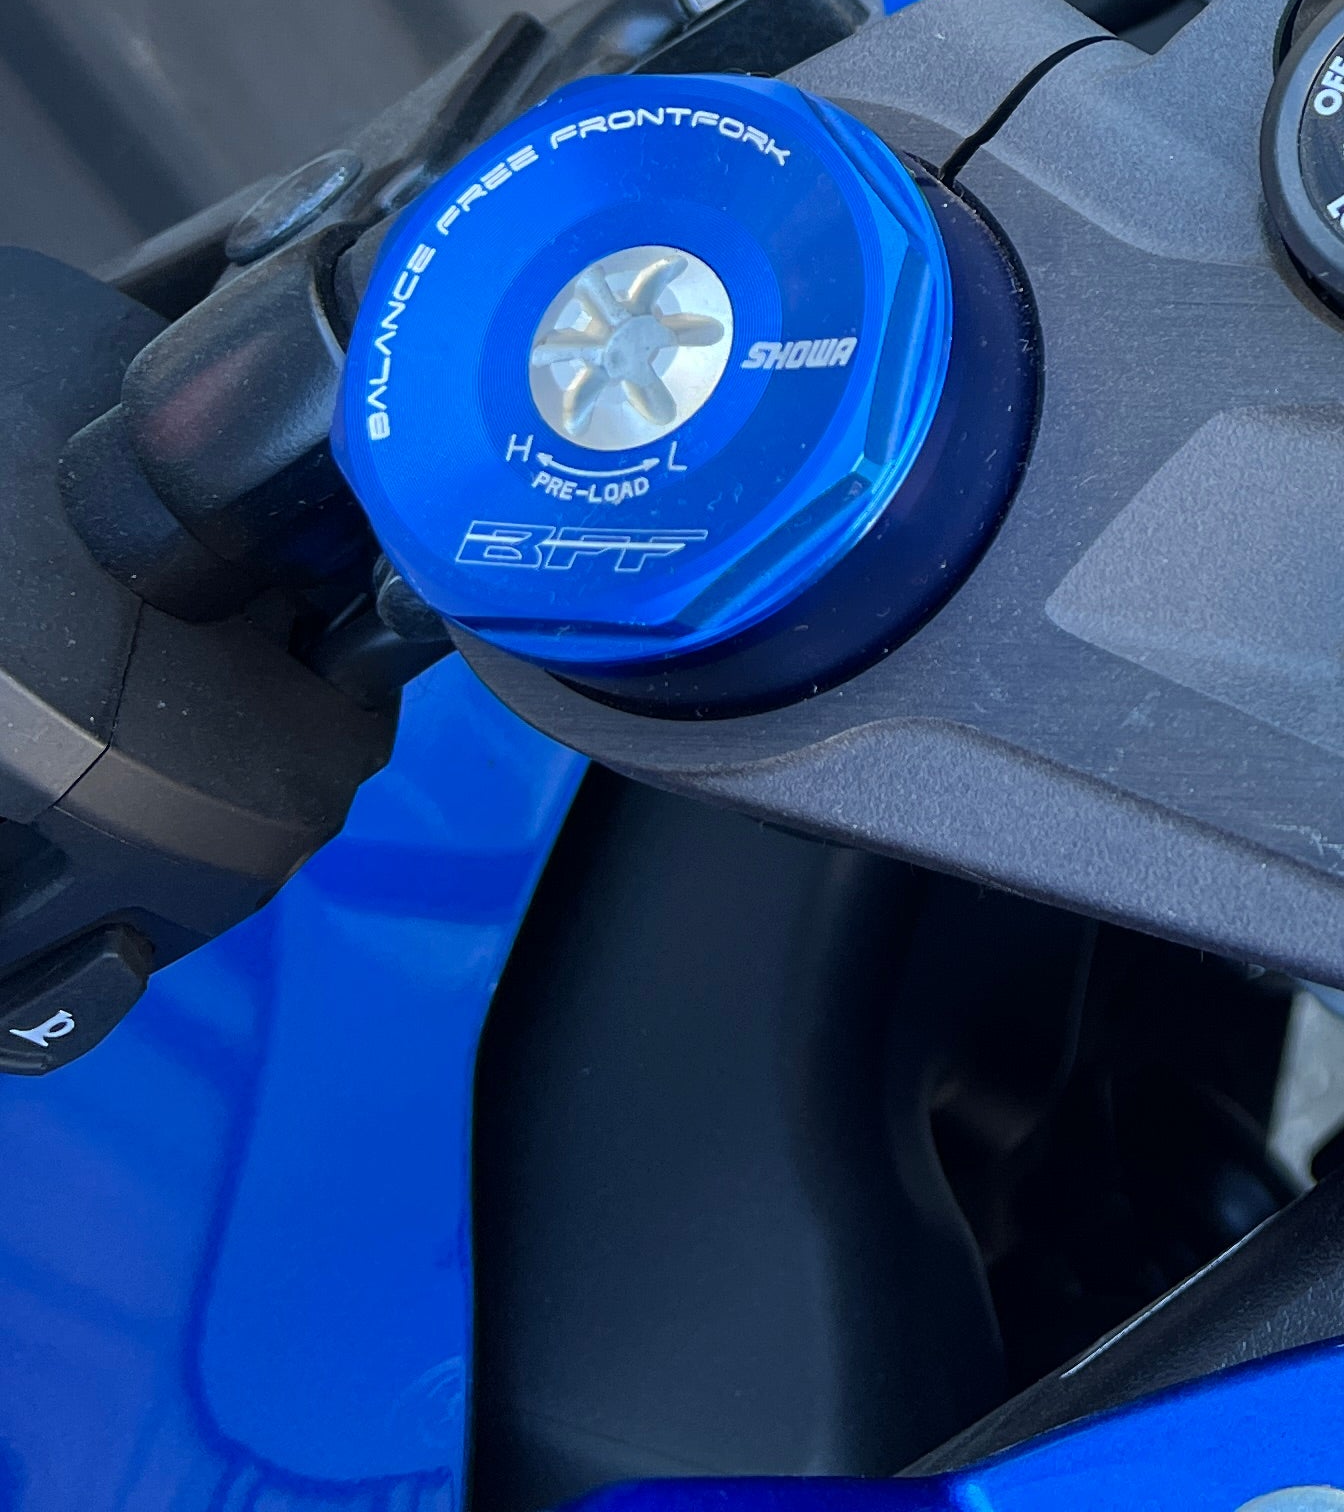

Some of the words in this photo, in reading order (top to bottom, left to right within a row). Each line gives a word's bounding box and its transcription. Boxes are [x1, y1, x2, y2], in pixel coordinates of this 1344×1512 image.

[367, 243, 437, 440] BALANCE
[436, 145, 539, 236] FREE
[550, 107, 791, 166] FRONTFORK
[740, 336, 857, 370] SHOWA
[505, 434, 534, 463] H
[667, 441, 688, 471] L
[532, 472, 650, 506] PRE-LOAD
[454, 520, 708, 572] BFF
